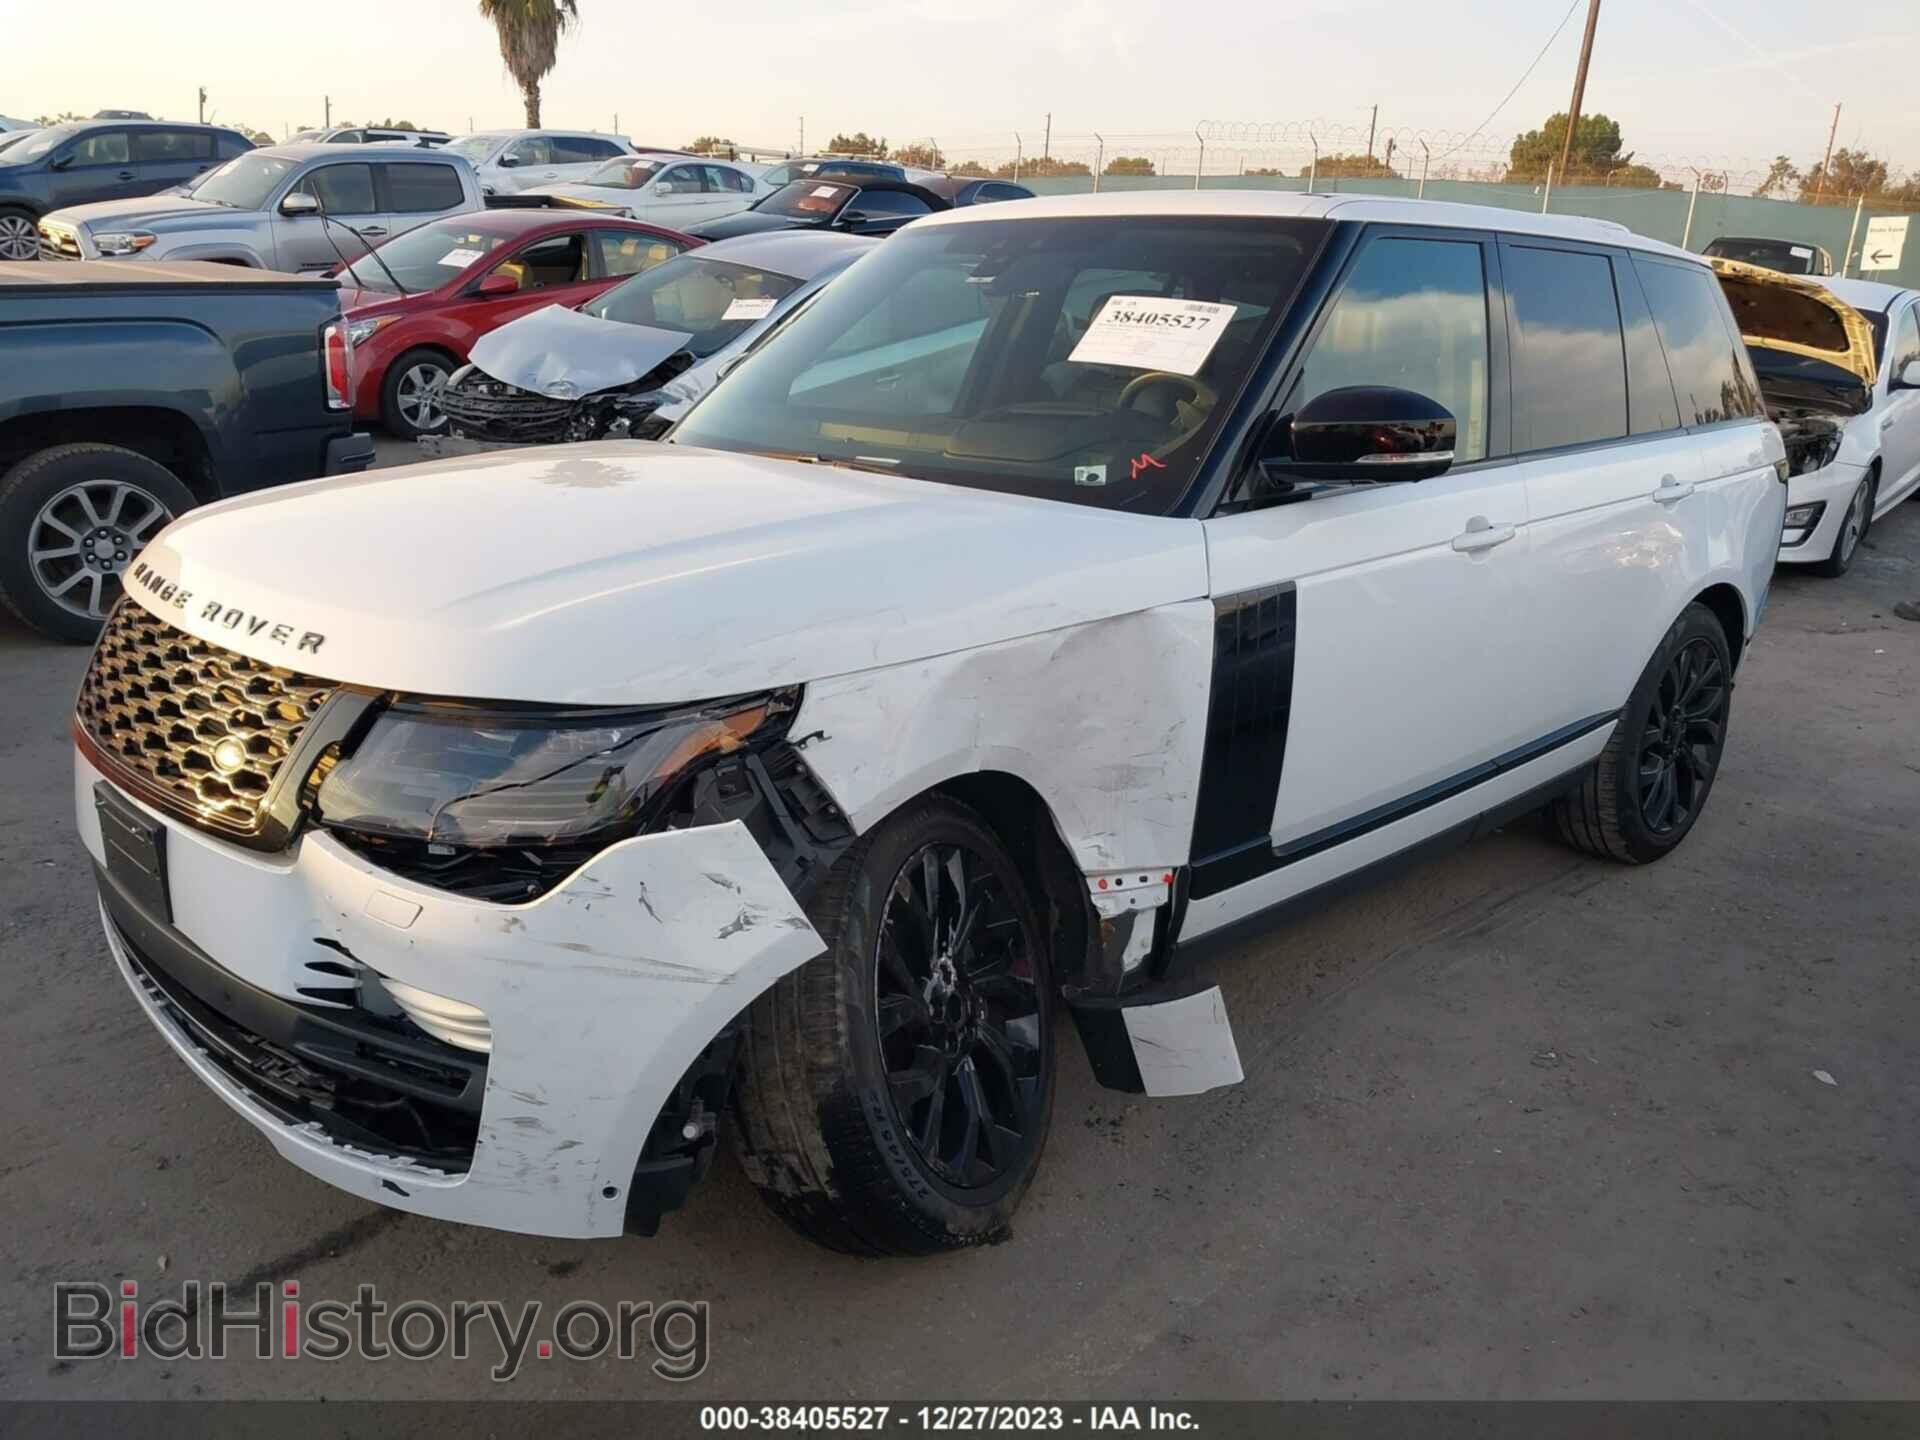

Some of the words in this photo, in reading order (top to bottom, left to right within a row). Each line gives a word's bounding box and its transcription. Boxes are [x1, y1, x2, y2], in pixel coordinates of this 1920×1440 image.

[1106, 309, 1212, 331] 38405527
[133, 562, 193, 609] RANGE
[200, 600, 325, 655] ROVER
